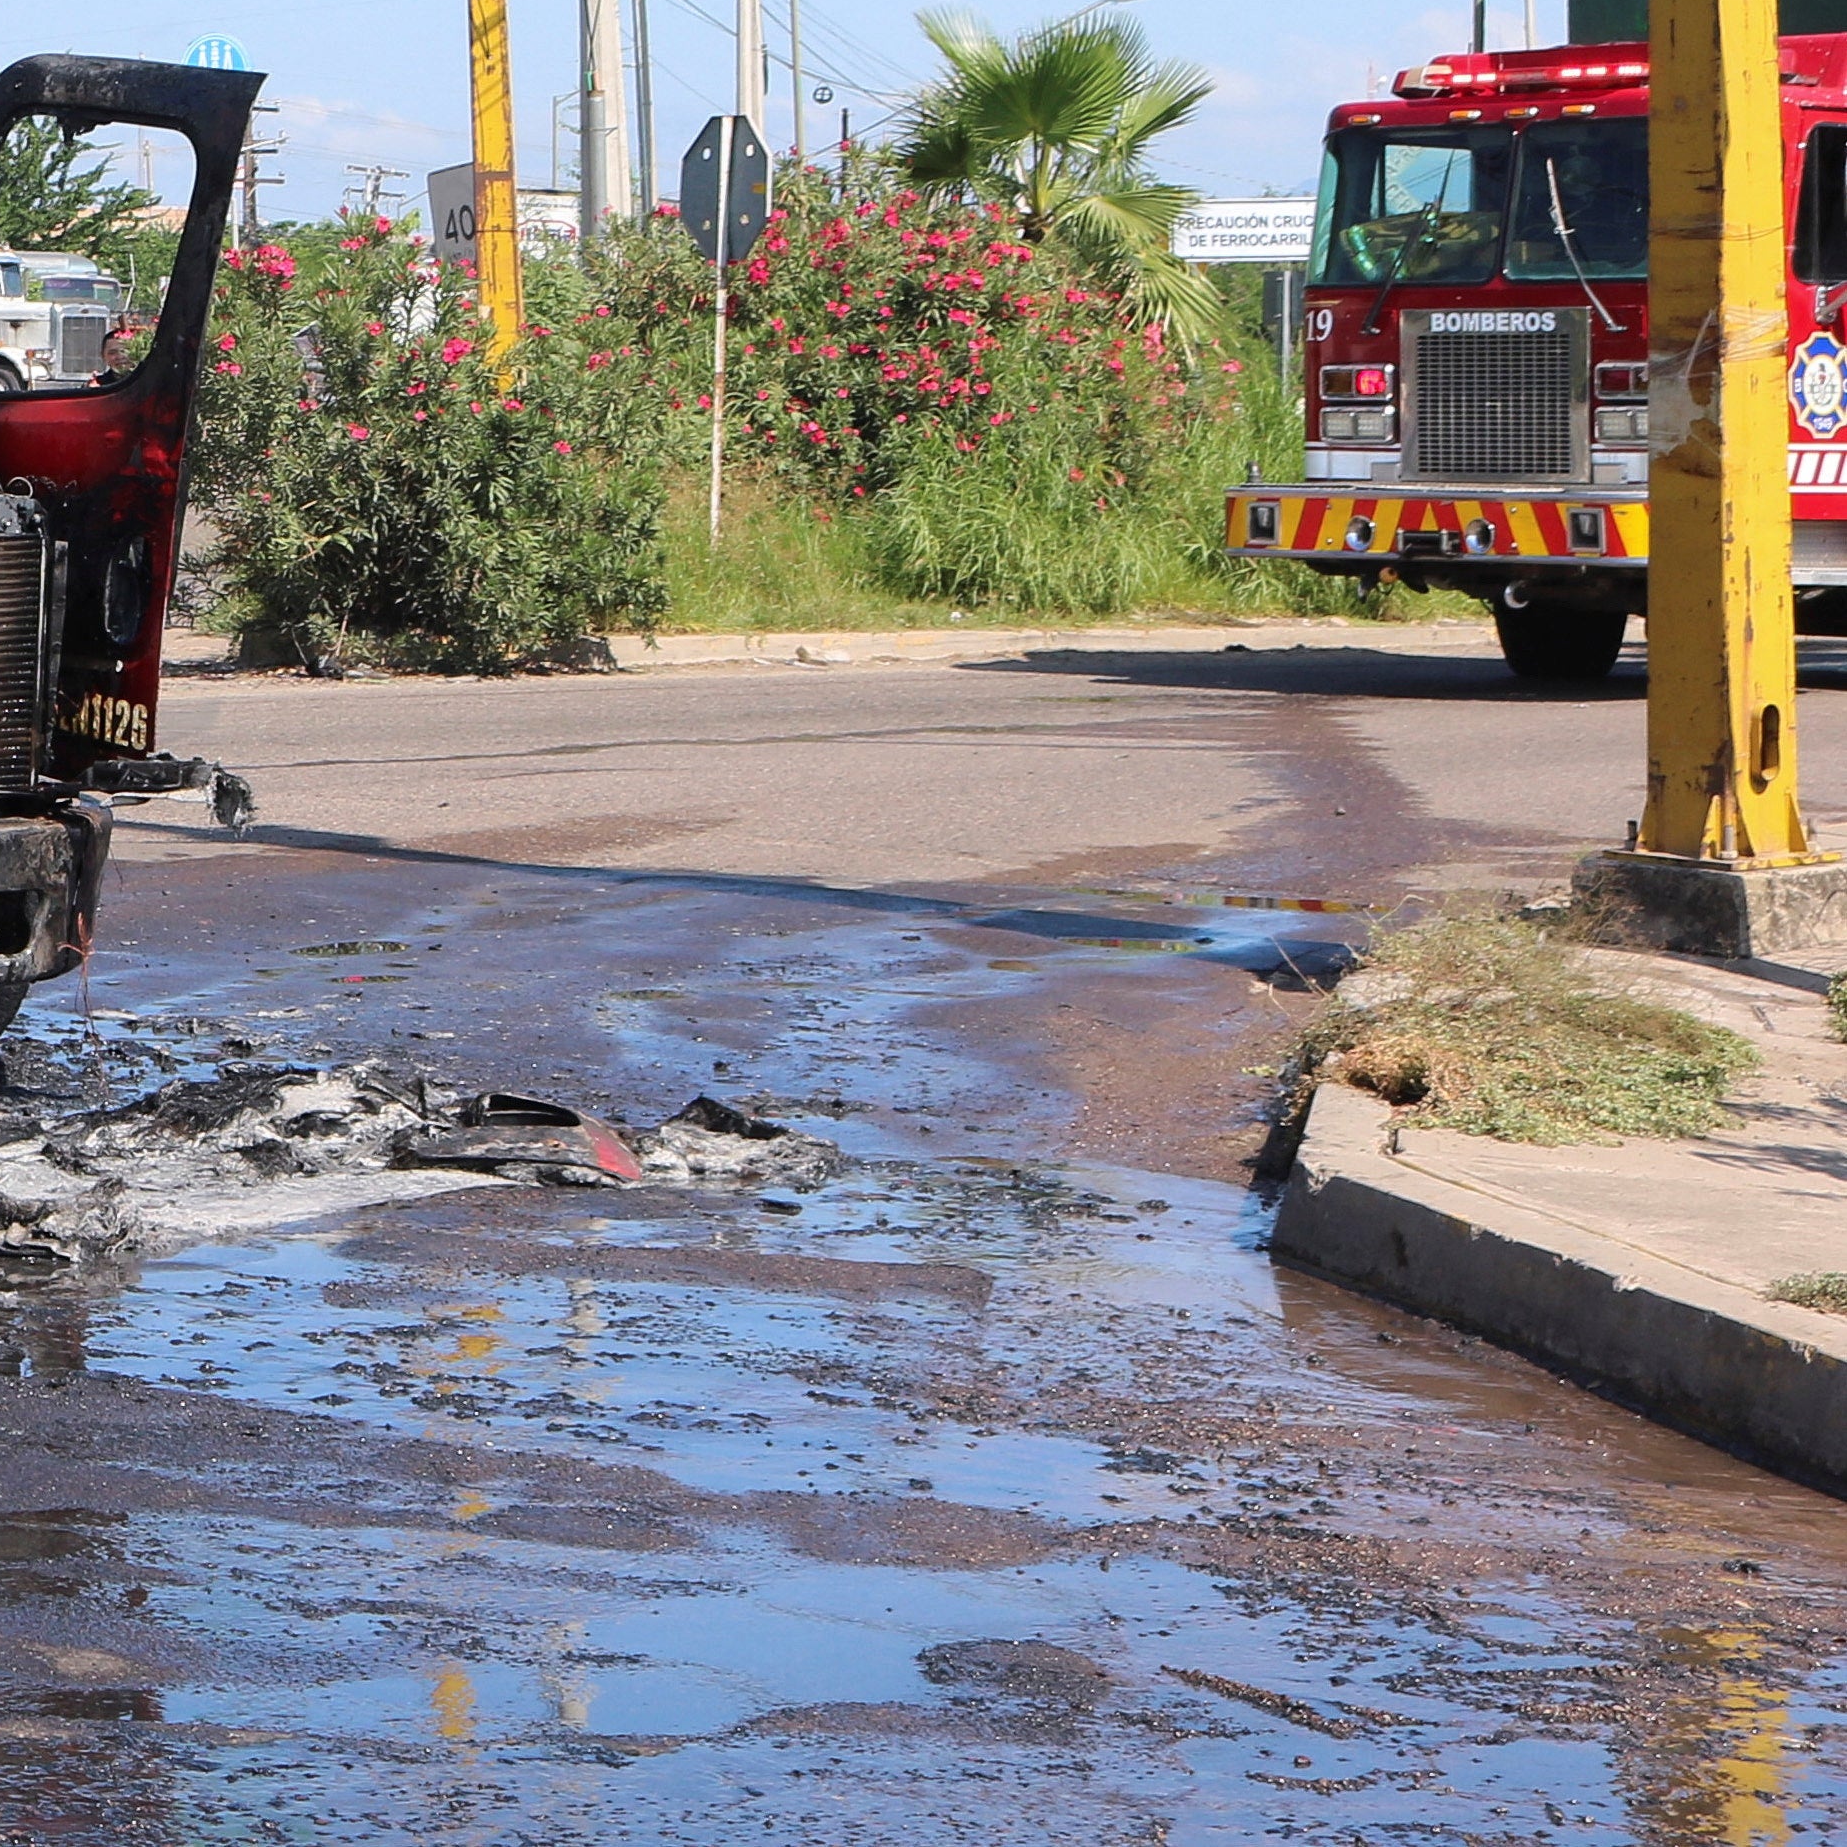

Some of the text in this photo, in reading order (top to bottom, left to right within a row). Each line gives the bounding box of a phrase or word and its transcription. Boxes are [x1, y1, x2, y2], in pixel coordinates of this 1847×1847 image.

[445, 204, 475, 244] 40
[1177, 213, 1269, 230] PRECAUCIÓN
[1189, 233, 1312, 247] DE FERROCARRIL
[1430, 312, 1556, 333] BOMBEROS
